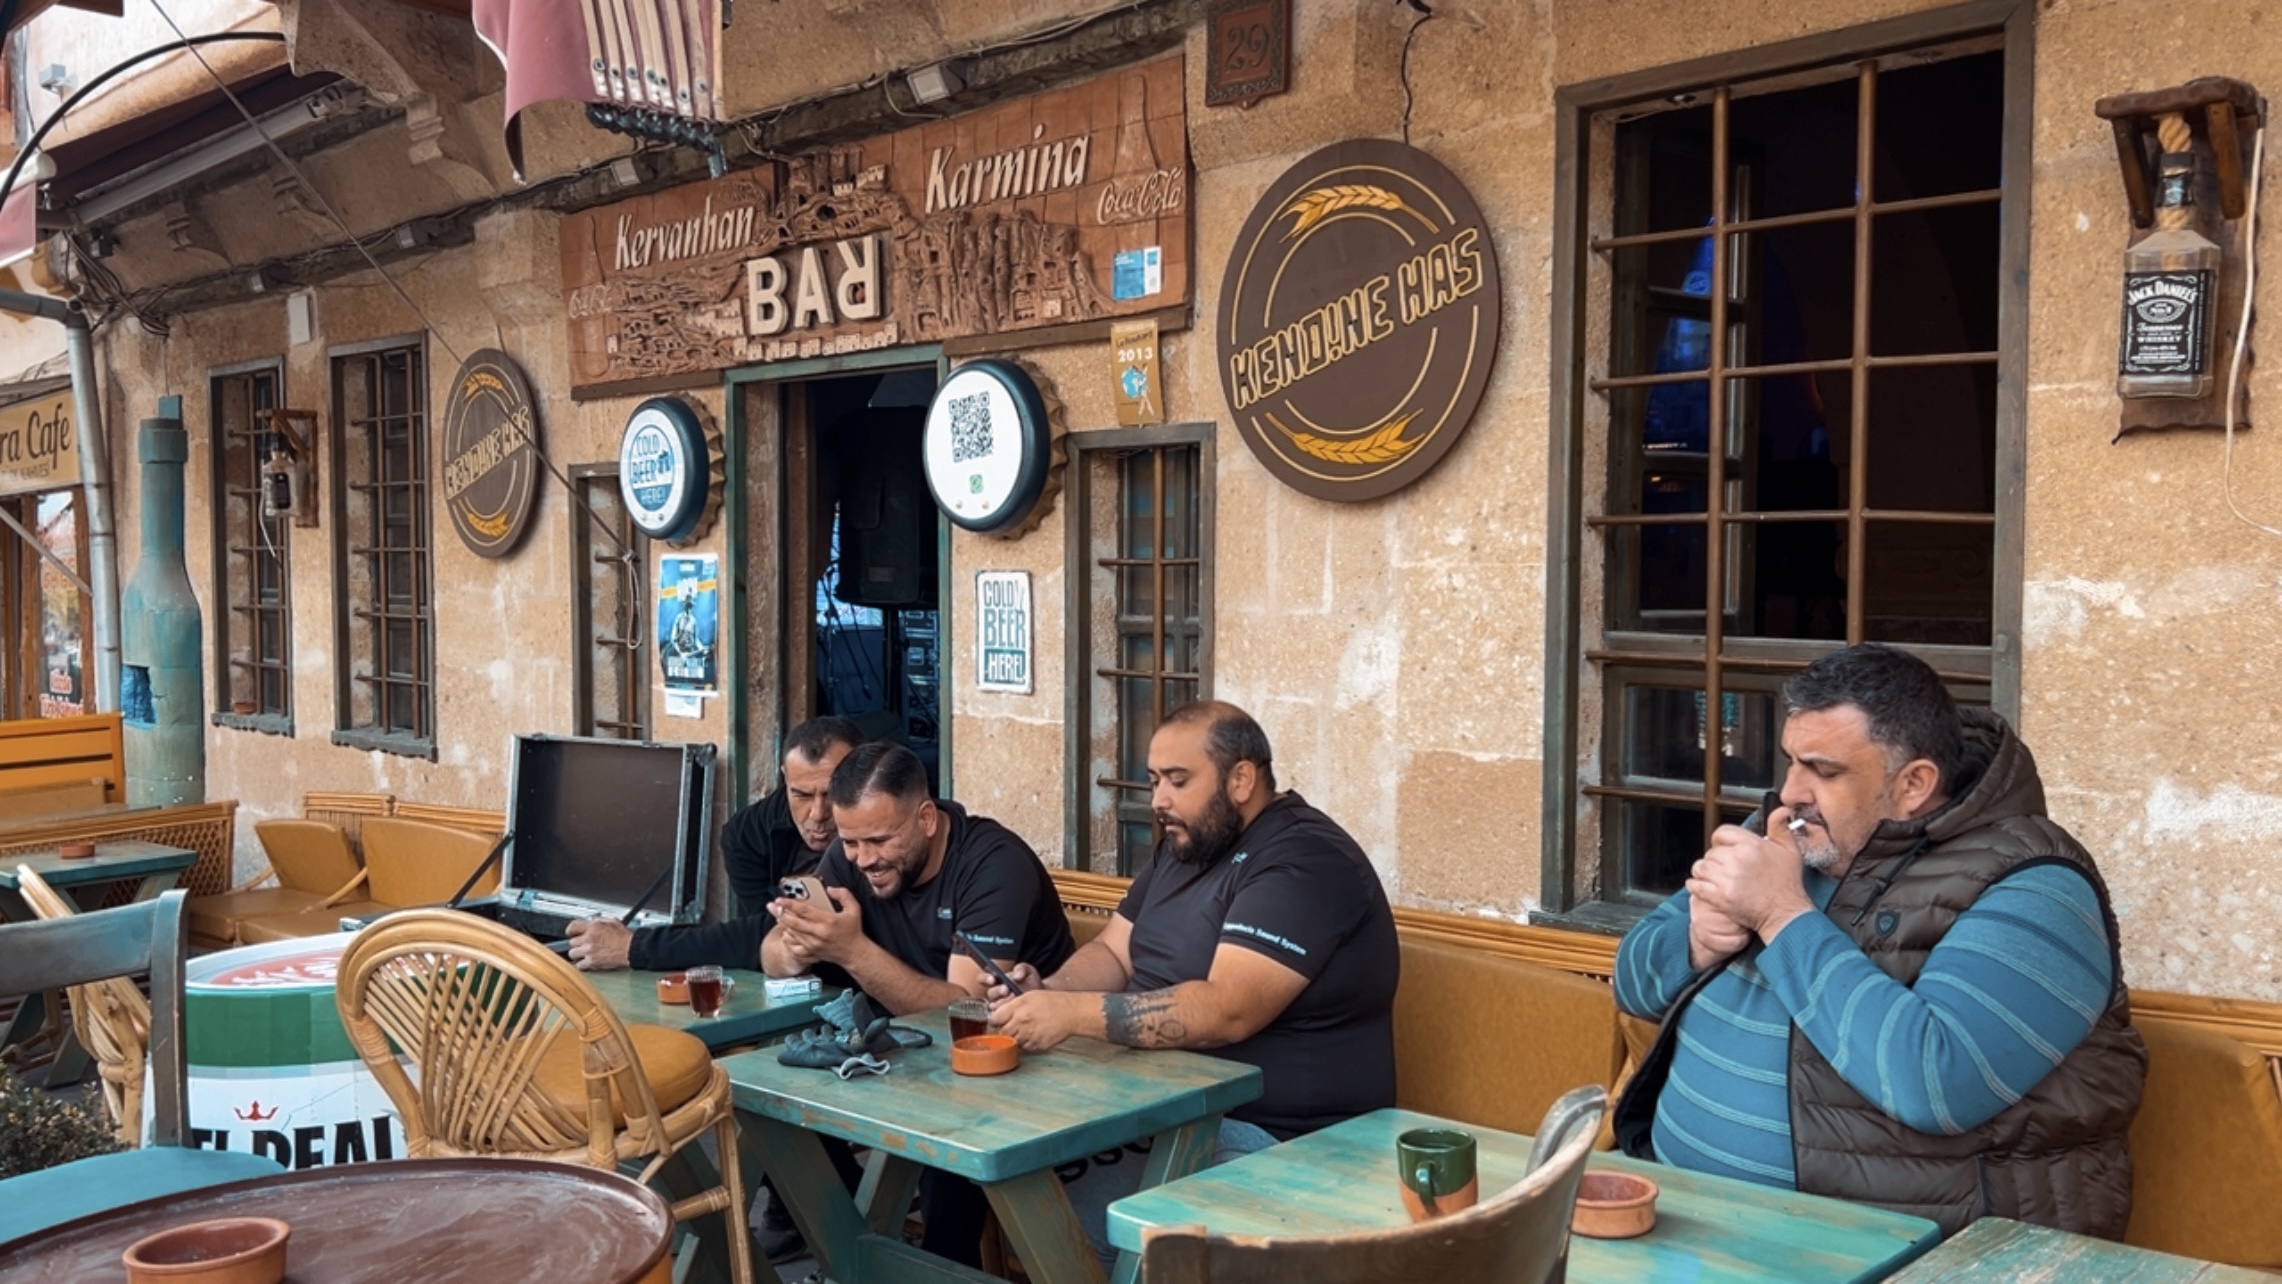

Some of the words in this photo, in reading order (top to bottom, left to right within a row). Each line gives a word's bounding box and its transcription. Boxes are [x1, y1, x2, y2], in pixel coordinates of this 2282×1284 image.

[1225, 23, 1270, 71] 29
[924, 123, 1091, 215] Karmina
[615, 195, 755, 271] Kervanhan
[1397, 227, 1483, 325] HAS
[2128, 285, 2154, 306] JACK
[1117, 347, 1153, 363] 2013
[27, 402, 71, 470] Cafe
[636, 433, 660, 457] COLD
[632, 460, 657, 484] BEER
[983, 580, 1014, 607] COLD
[984, 608, 1026, 648] BEER
